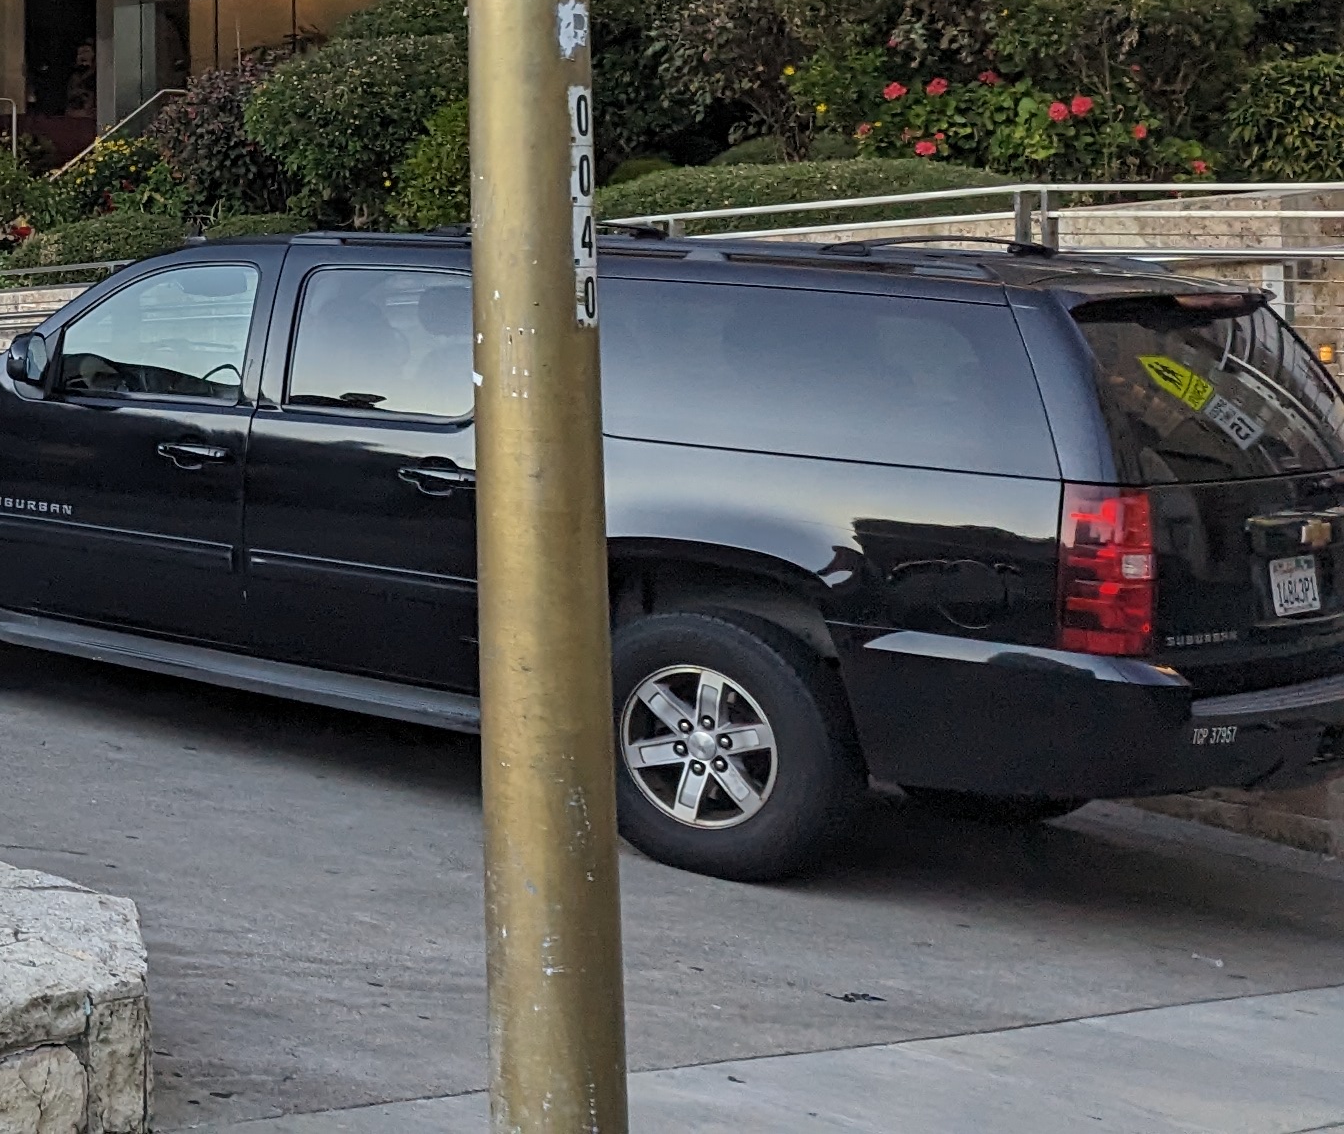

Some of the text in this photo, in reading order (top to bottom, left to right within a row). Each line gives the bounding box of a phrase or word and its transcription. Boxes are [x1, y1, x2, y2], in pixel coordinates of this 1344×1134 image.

[1166, 631, 1238, 646] SUBURBAN
[1192, 726, 1237, 745] TCP 37957
